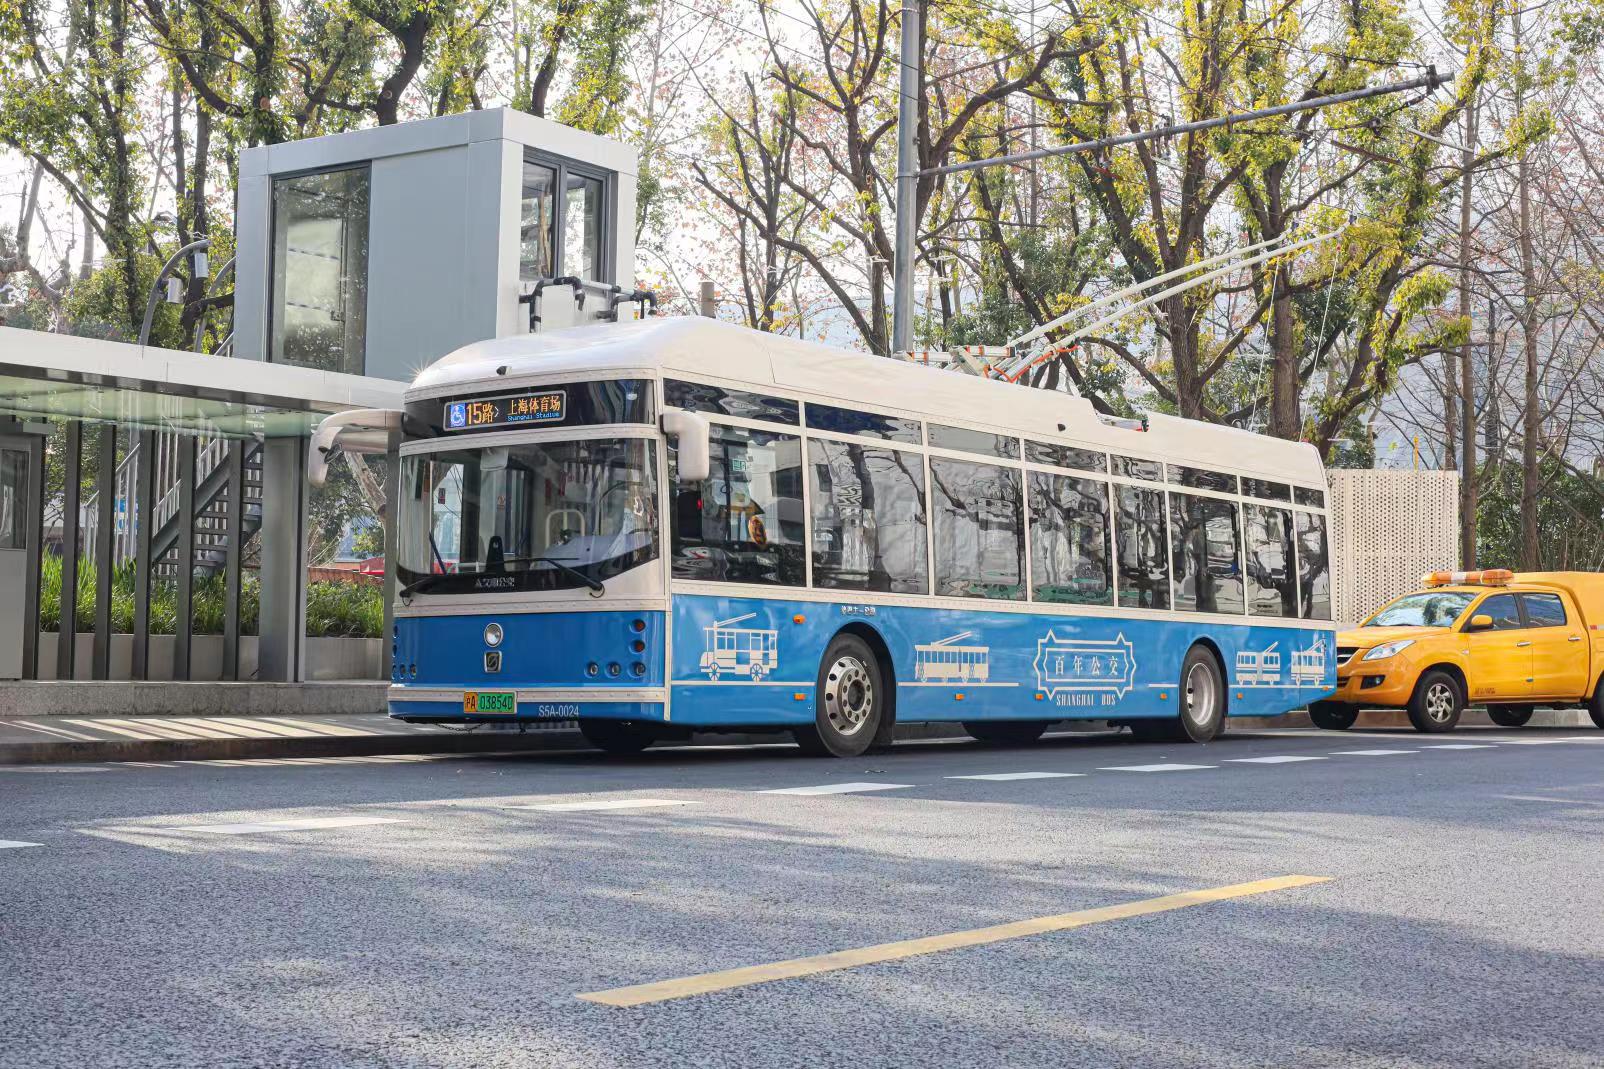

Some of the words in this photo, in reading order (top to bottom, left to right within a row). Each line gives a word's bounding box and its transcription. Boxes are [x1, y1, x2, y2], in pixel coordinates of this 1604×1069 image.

[466, 402, 493, 425] 15路
[508, 395, 561, 415] 上海体育场
[507, 414, 533, 422] Shanghai
[1053, 655, 1118, 676] 百年公交
[1056, 693, 1094, 706] SHANGHAI
[1101, 693, 1116, 706] BUS
[538, 705, 579, 718] S5A-0024
